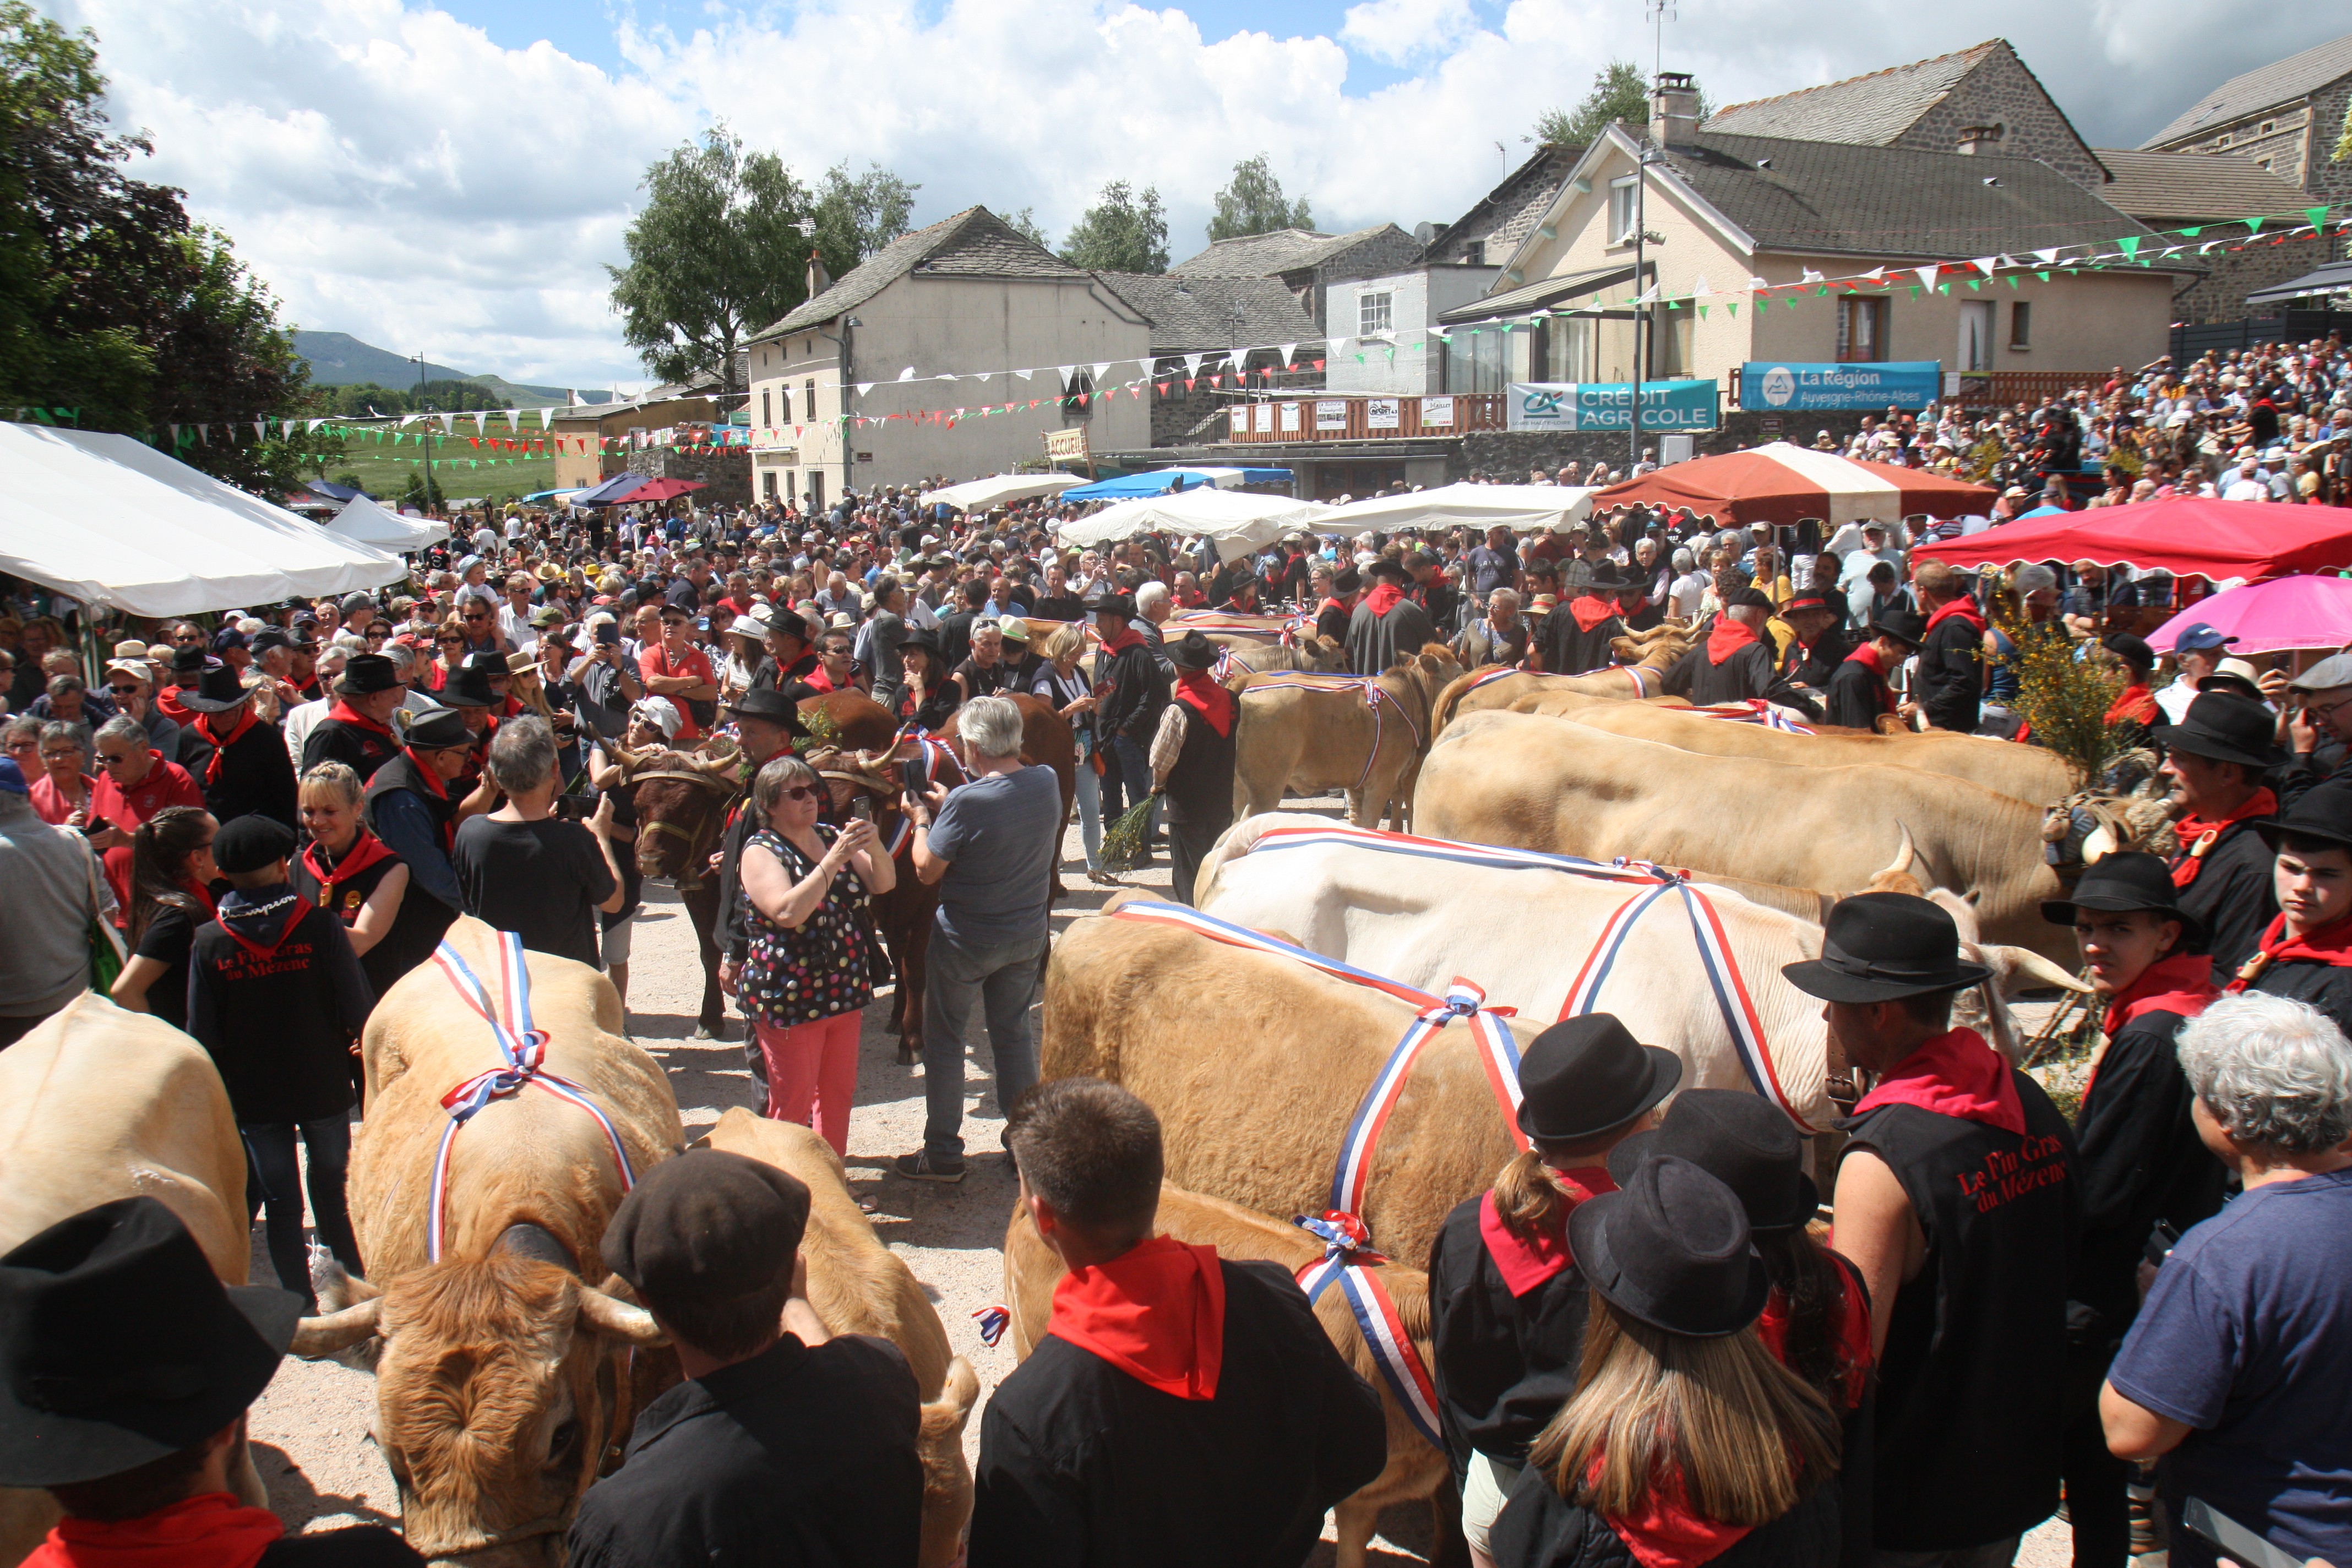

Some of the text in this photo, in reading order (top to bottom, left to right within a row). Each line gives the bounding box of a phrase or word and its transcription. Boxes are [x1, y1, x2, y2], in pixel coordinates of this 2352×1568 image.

[1800, 370, 1880, 389] La Région
[1581, 388, 1671, 406] CRÉDIT
[1800, 391, 1920, 405] Auvergne-Rhône-Alpes
[1581, 409, 1707, 426] AGRCOLE
[1050, 436, 1082, 456] ACCUEIL
[218, 894, 298, 921] Champion
[217, 958, 234, 971] Le
[226, 970, 244, 981] du
[1957, 1172, 1986, 1196] Le
[1985, 1150, 2019, 1182] Fin
[1977, 1191, 2000, 1213] du
